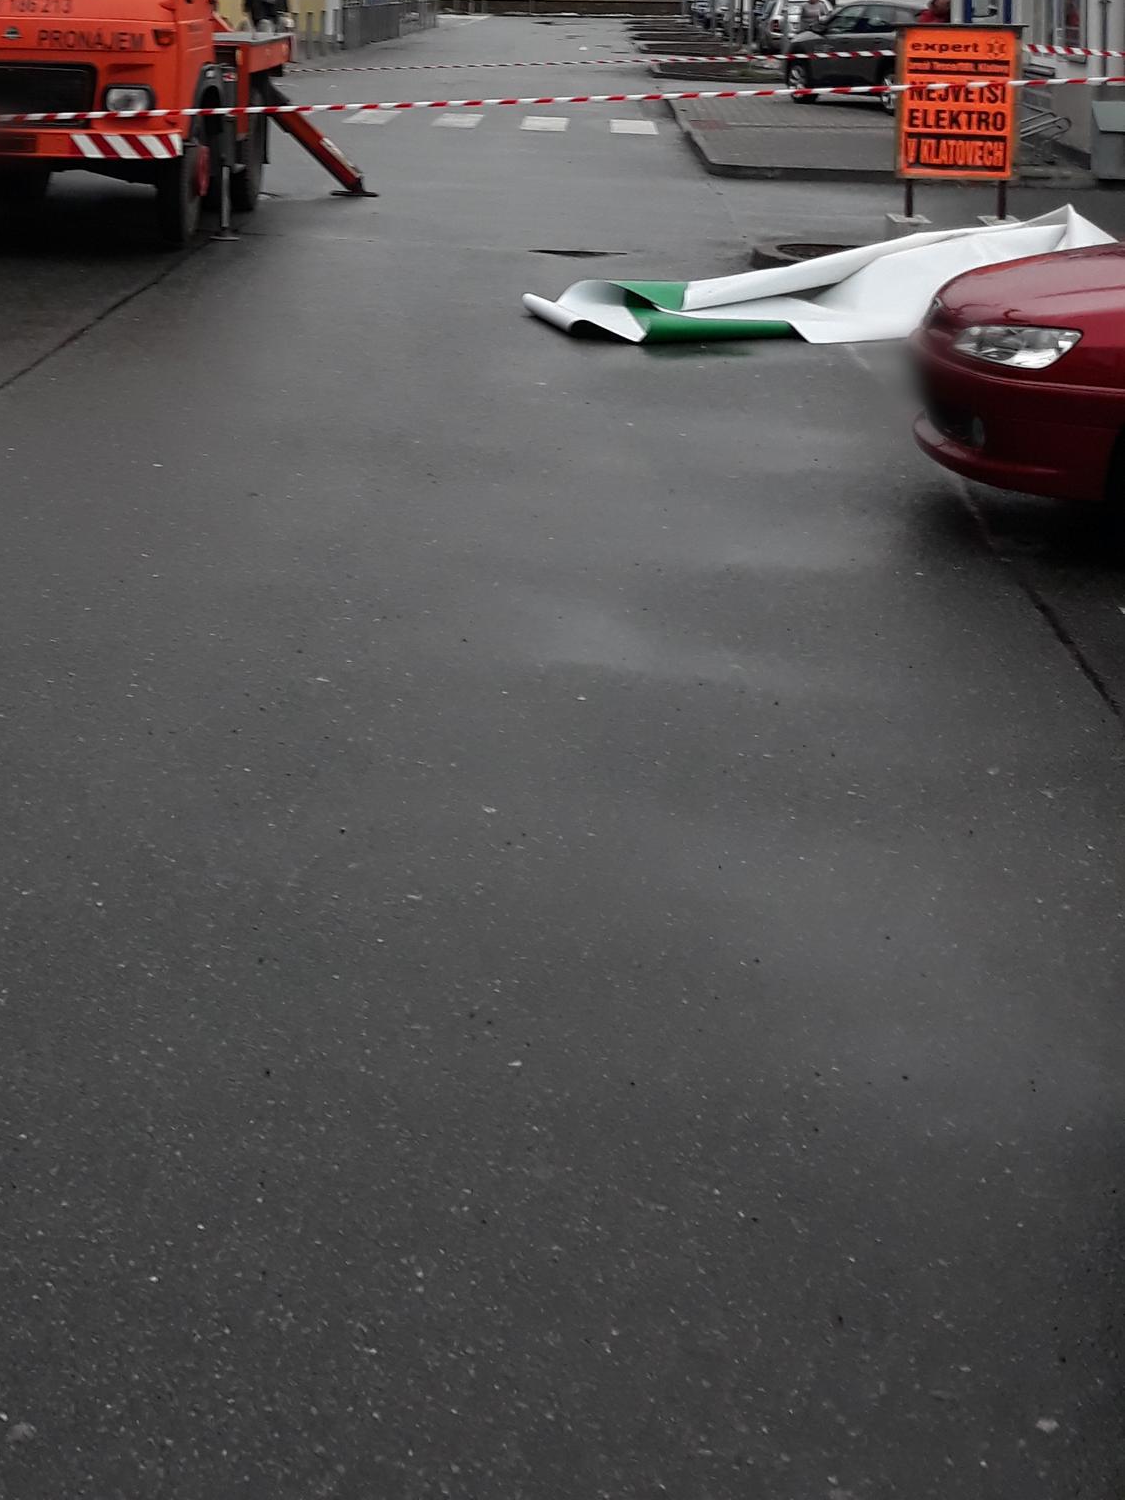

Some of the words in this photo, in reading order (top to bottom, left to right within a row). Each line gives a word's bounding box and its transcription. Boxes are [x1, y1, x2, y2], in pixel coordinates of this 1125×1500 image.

[37, 27, 144, 51] PRONÁJEM
[911, 42, 979, 53] expert
[908, 108, 1006, 131] ELEKTRO
[906, 138, 918, 164] V
[920, 139, 1005, 167] KLATOVECH
